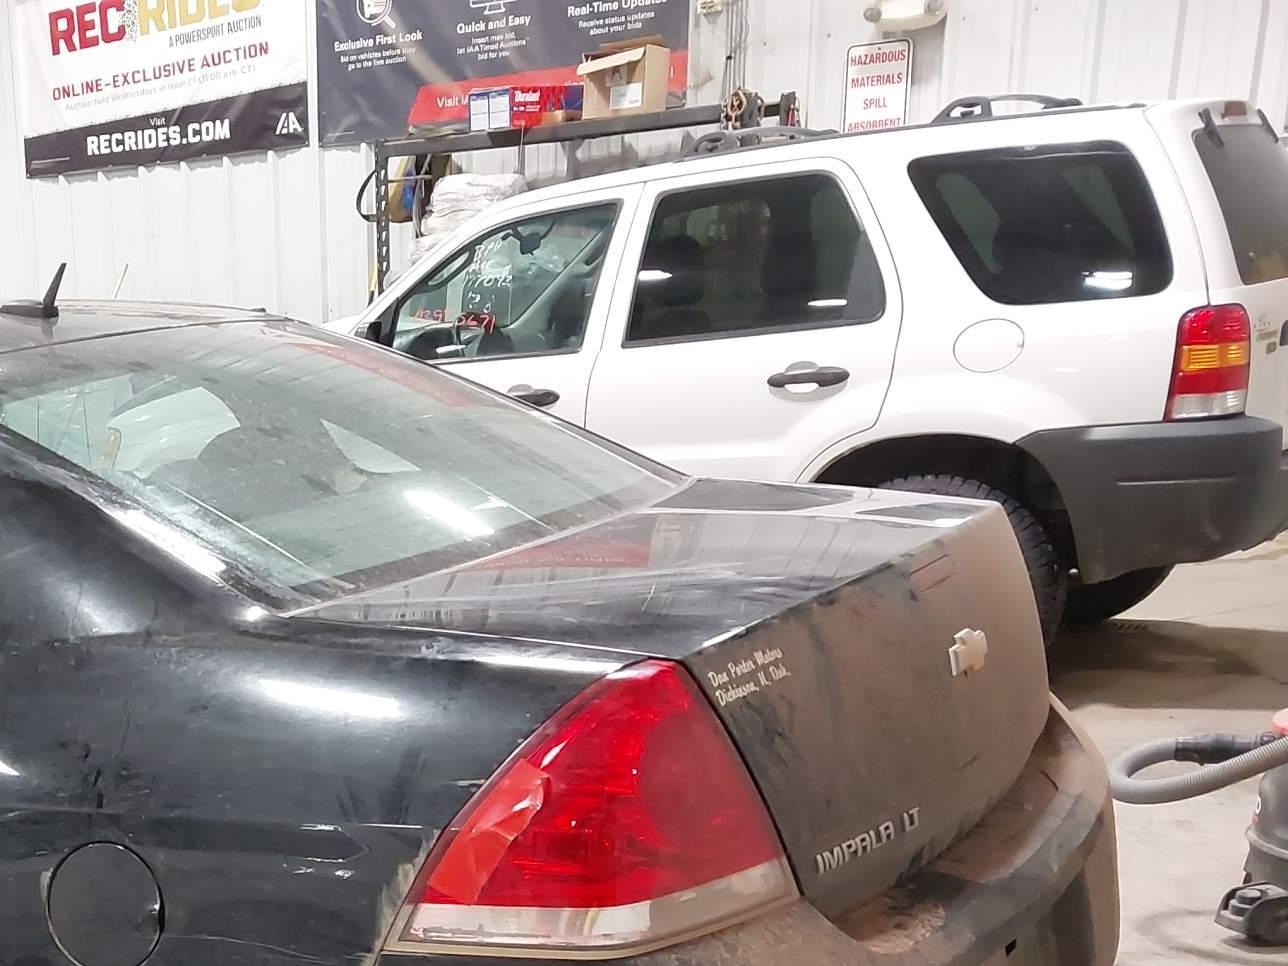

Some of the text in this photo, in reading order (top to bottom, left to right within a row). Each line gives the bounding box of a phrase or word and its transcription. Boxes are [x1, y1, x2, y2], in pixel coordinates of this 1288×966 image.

[567, 1, 619, 17] Real-Time
[605, 15, 626, 25] status
[627, 11, 655, 22] updates
[48, 0, 261, 56] REC RID
[175, 23, 224, 47] POWERSPORT
[227, 15, 262, 34] AUCTION
[456, 14, 531, 34] Quick and Easy
[589, 26, 609, 36] about
[610, 24, 626, 34] your
[334, 29, 423, 52] Exclusive First Look
[850, 49, 907, 67] HAZARDOUS
[52, 41, 270, 101] ONLINE-EXCLUSIVE AUCTION
[850, 72, 903, 89] MATERIALS
[436, 96, 459, 108] Visit
[863, 97, 888, 110] SPILL
[149, 116, 167, 127] Visit
[86, 118, 232, 156] RECRIDES.COM
[707, 647, 783, 688] Dan Porter Motors
[715, 681, 760, 707] Dickinson,
[815, 806, 920, 875] IMPALA LT
